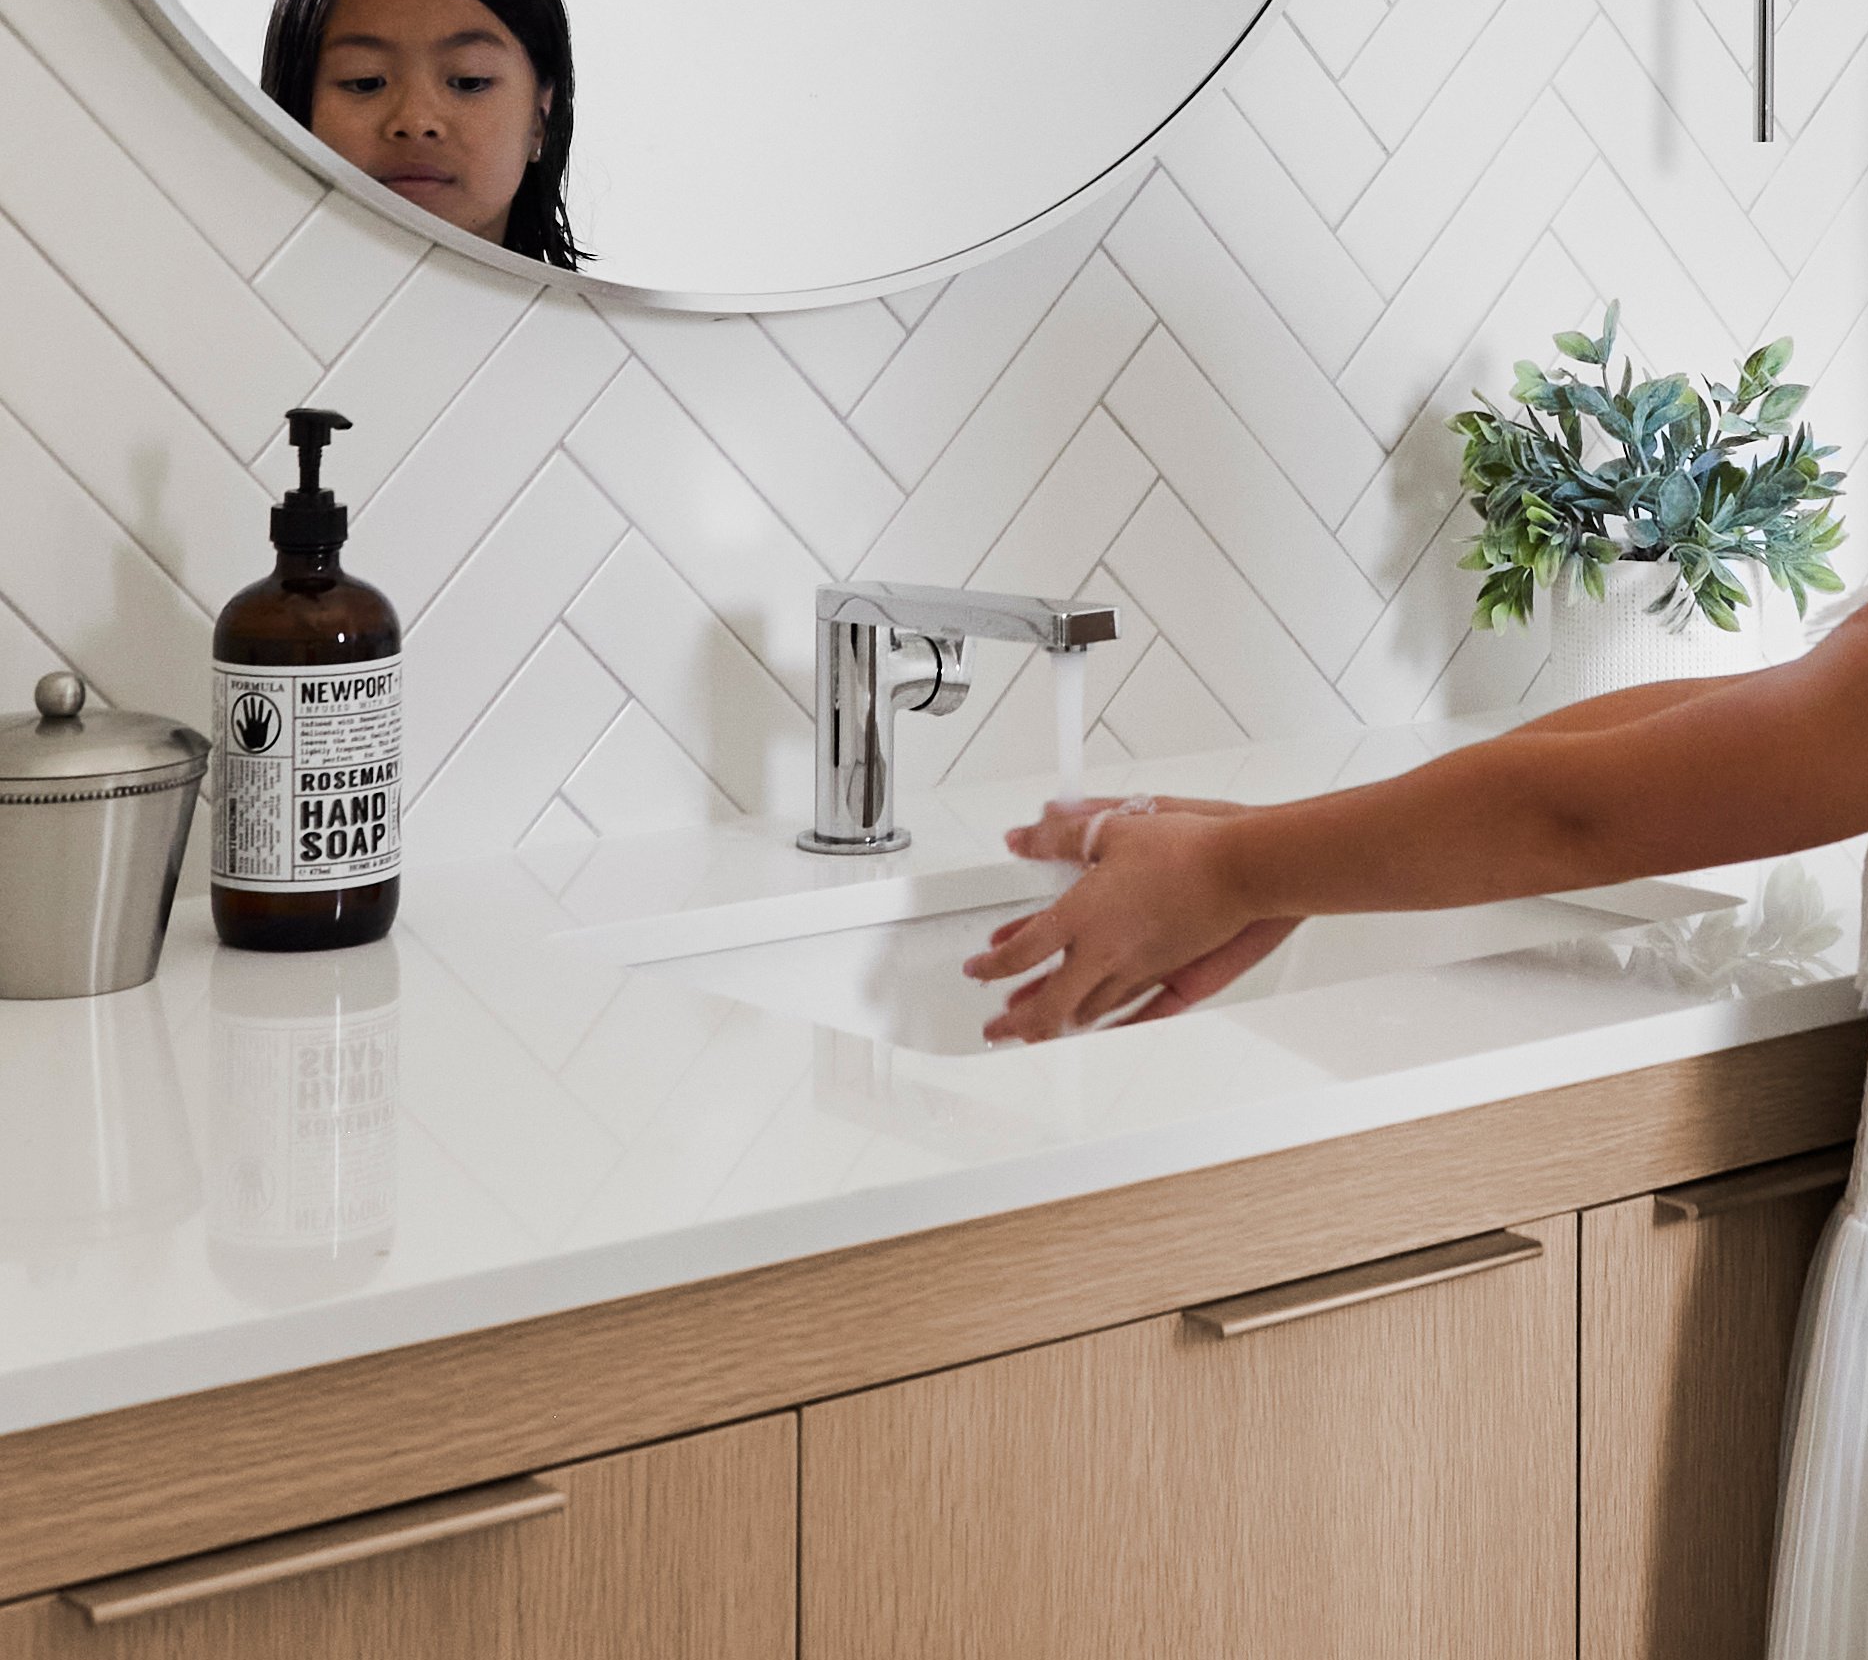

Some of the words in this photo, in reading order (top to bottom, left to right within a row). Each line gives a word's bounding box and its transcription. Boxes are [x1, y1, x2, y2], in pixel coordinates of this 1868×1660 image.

[231, 680, 284, 693] FORMULA
[301, 672, 393, 704] NEWPORT
[301, 761, 398, 792] ROSEMARY
[300, 791, 386, 830] HAND
[300, 823, 386, 862] SOAP
